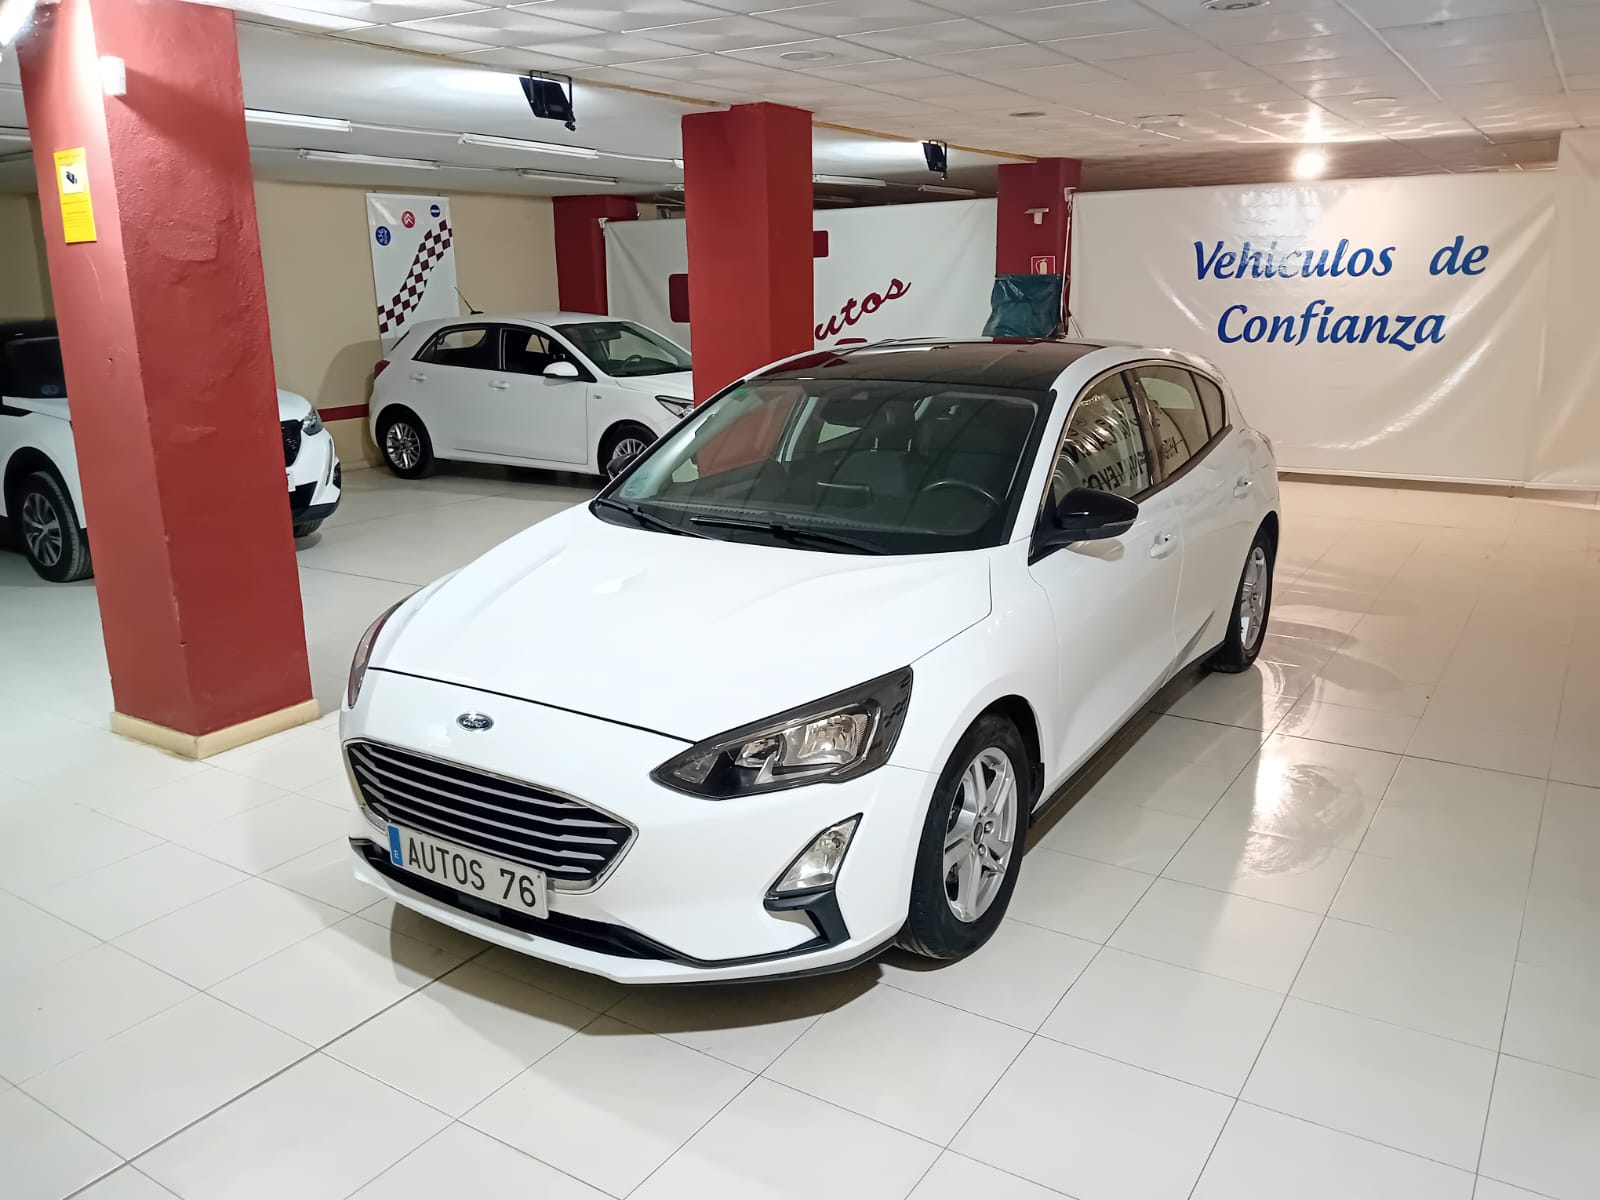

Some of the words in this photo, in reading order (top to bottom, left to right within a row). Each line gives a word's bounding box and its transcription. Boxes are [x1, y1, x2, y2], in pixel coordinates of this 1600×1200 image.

[1429, 235, 1490, 276] de
[814, 278, 912, 341] utos
[1217, 299, 1447, 351] Confianza
[408, 837, 485, 891] AUTOS
[500, 867, 536, 908] 76
